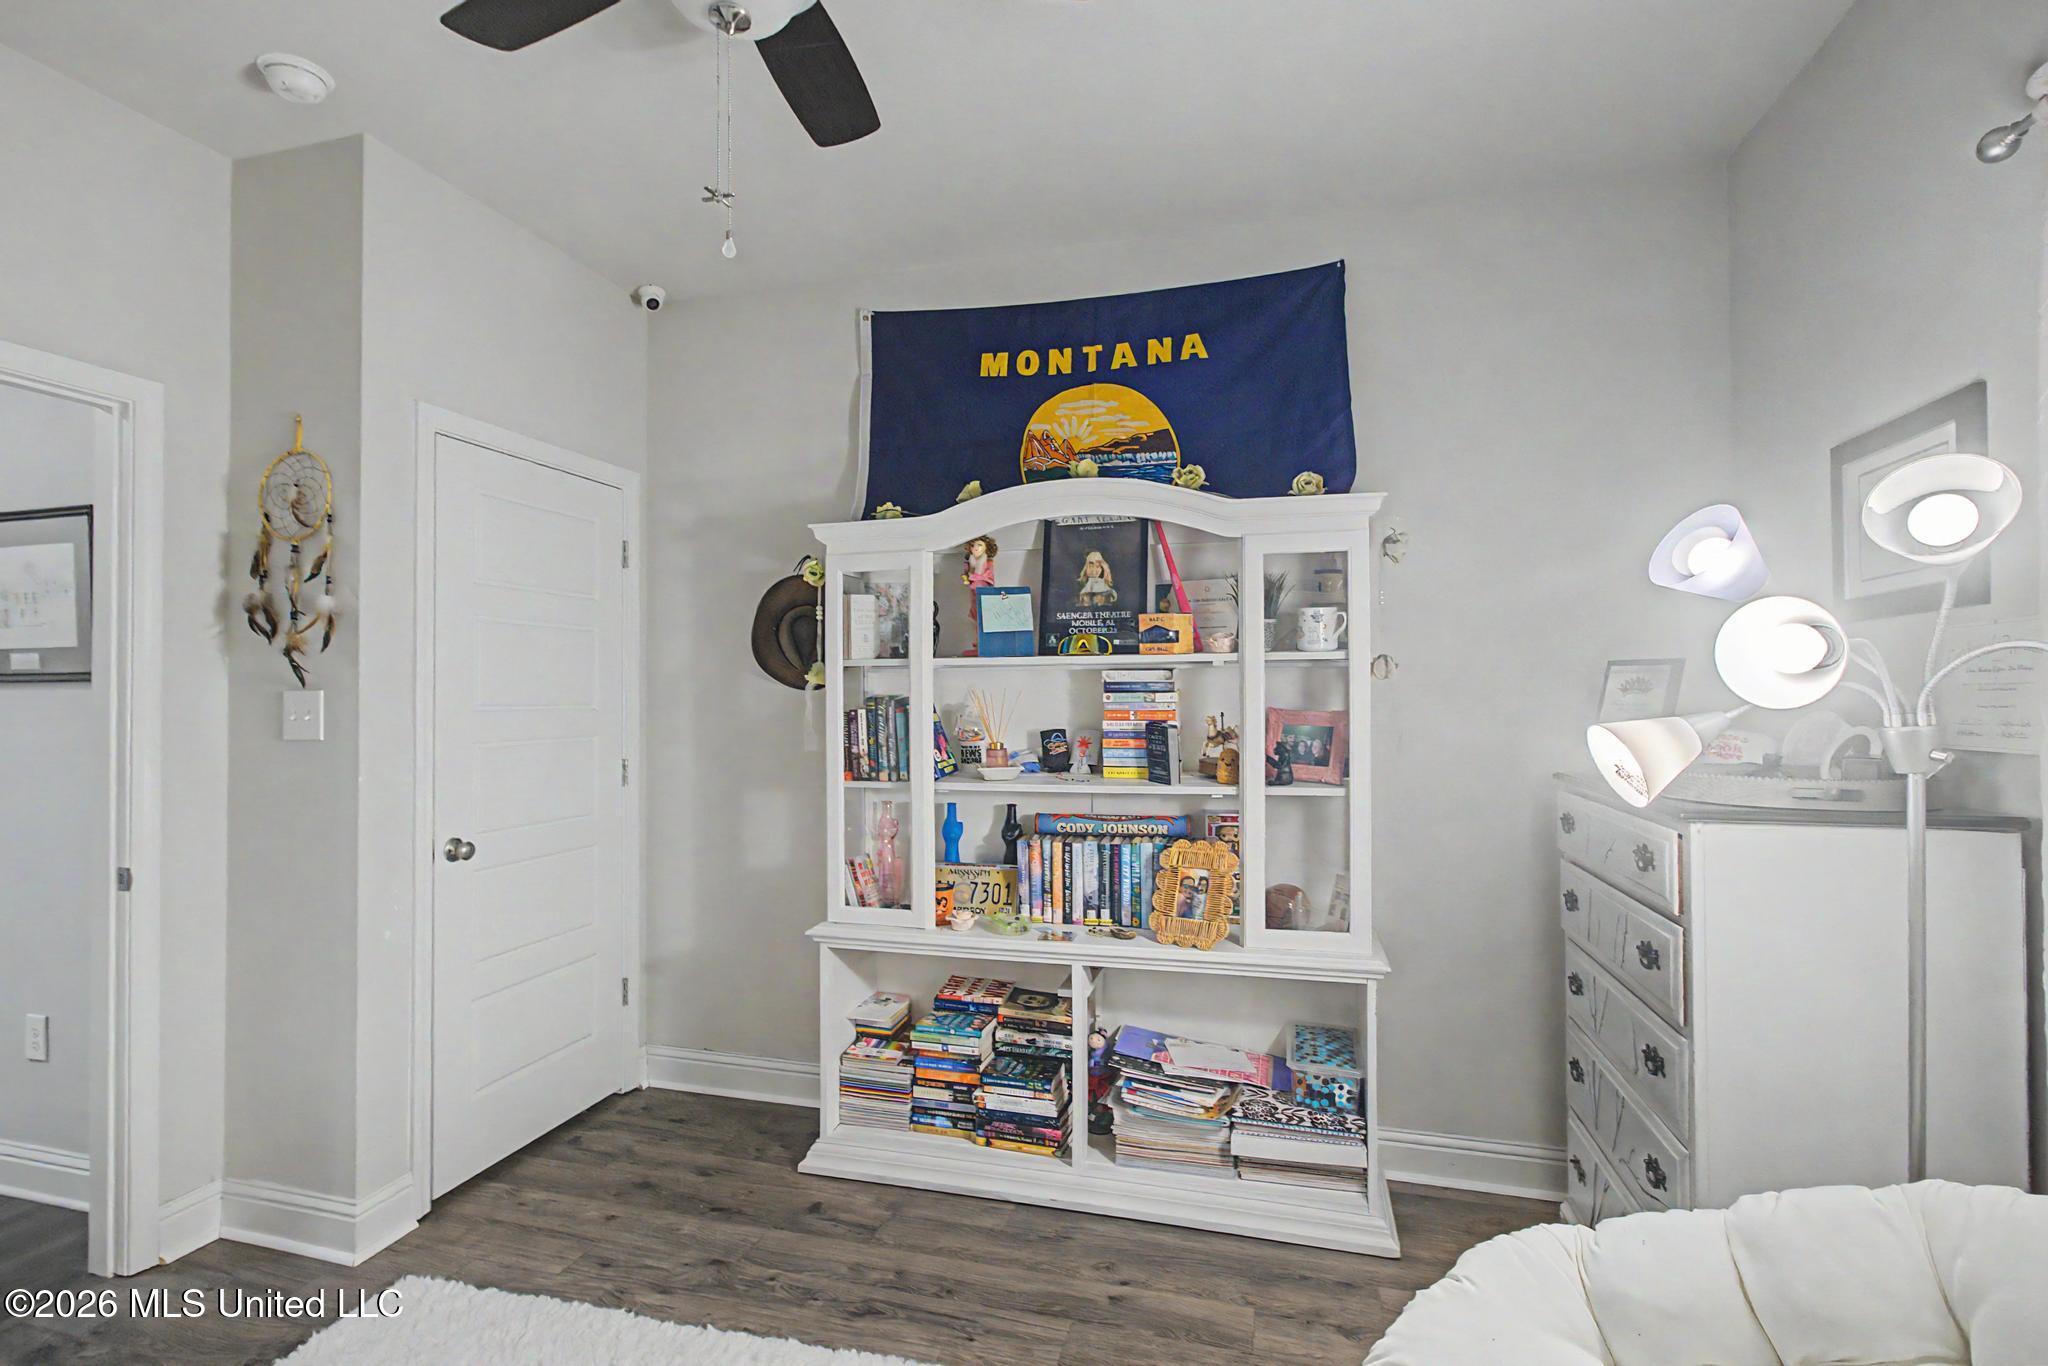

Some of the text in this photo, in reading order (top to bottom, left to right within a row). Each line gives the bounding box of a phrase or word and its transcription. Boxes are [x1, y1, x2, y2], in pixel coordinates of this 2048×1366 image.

[979, 332, 1209, 377] MONTANA
[1056, 822, 1169, 835] CODY JOHNSON
[969, 881, 1012, 905] 7301
